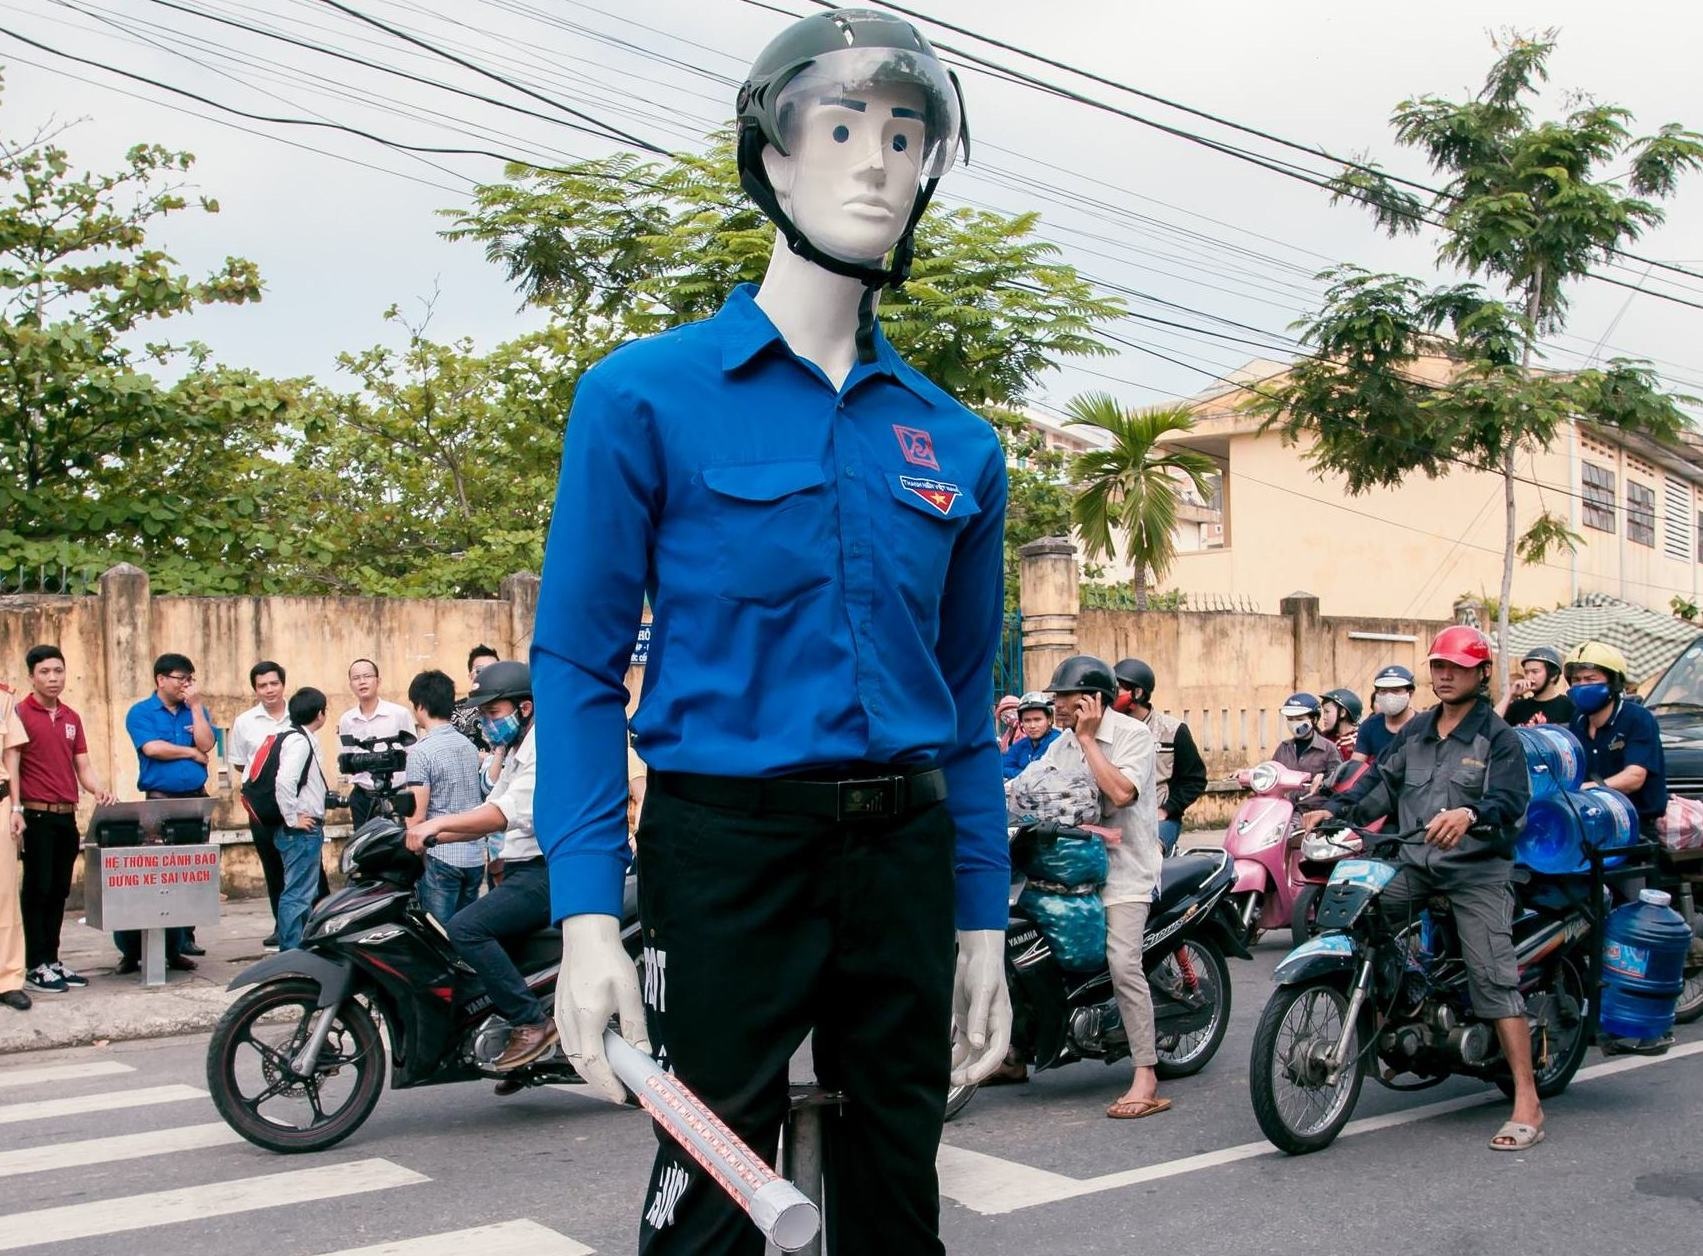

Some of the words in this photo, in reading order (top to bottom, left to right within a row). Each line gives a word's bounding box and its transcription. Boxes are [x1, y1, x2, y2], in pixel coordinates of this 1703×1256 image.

[143, 873, 157, 885] XE
[161, 872, 178, 884] SAI
[1008, 929, 1038, 947] YAMAHA
